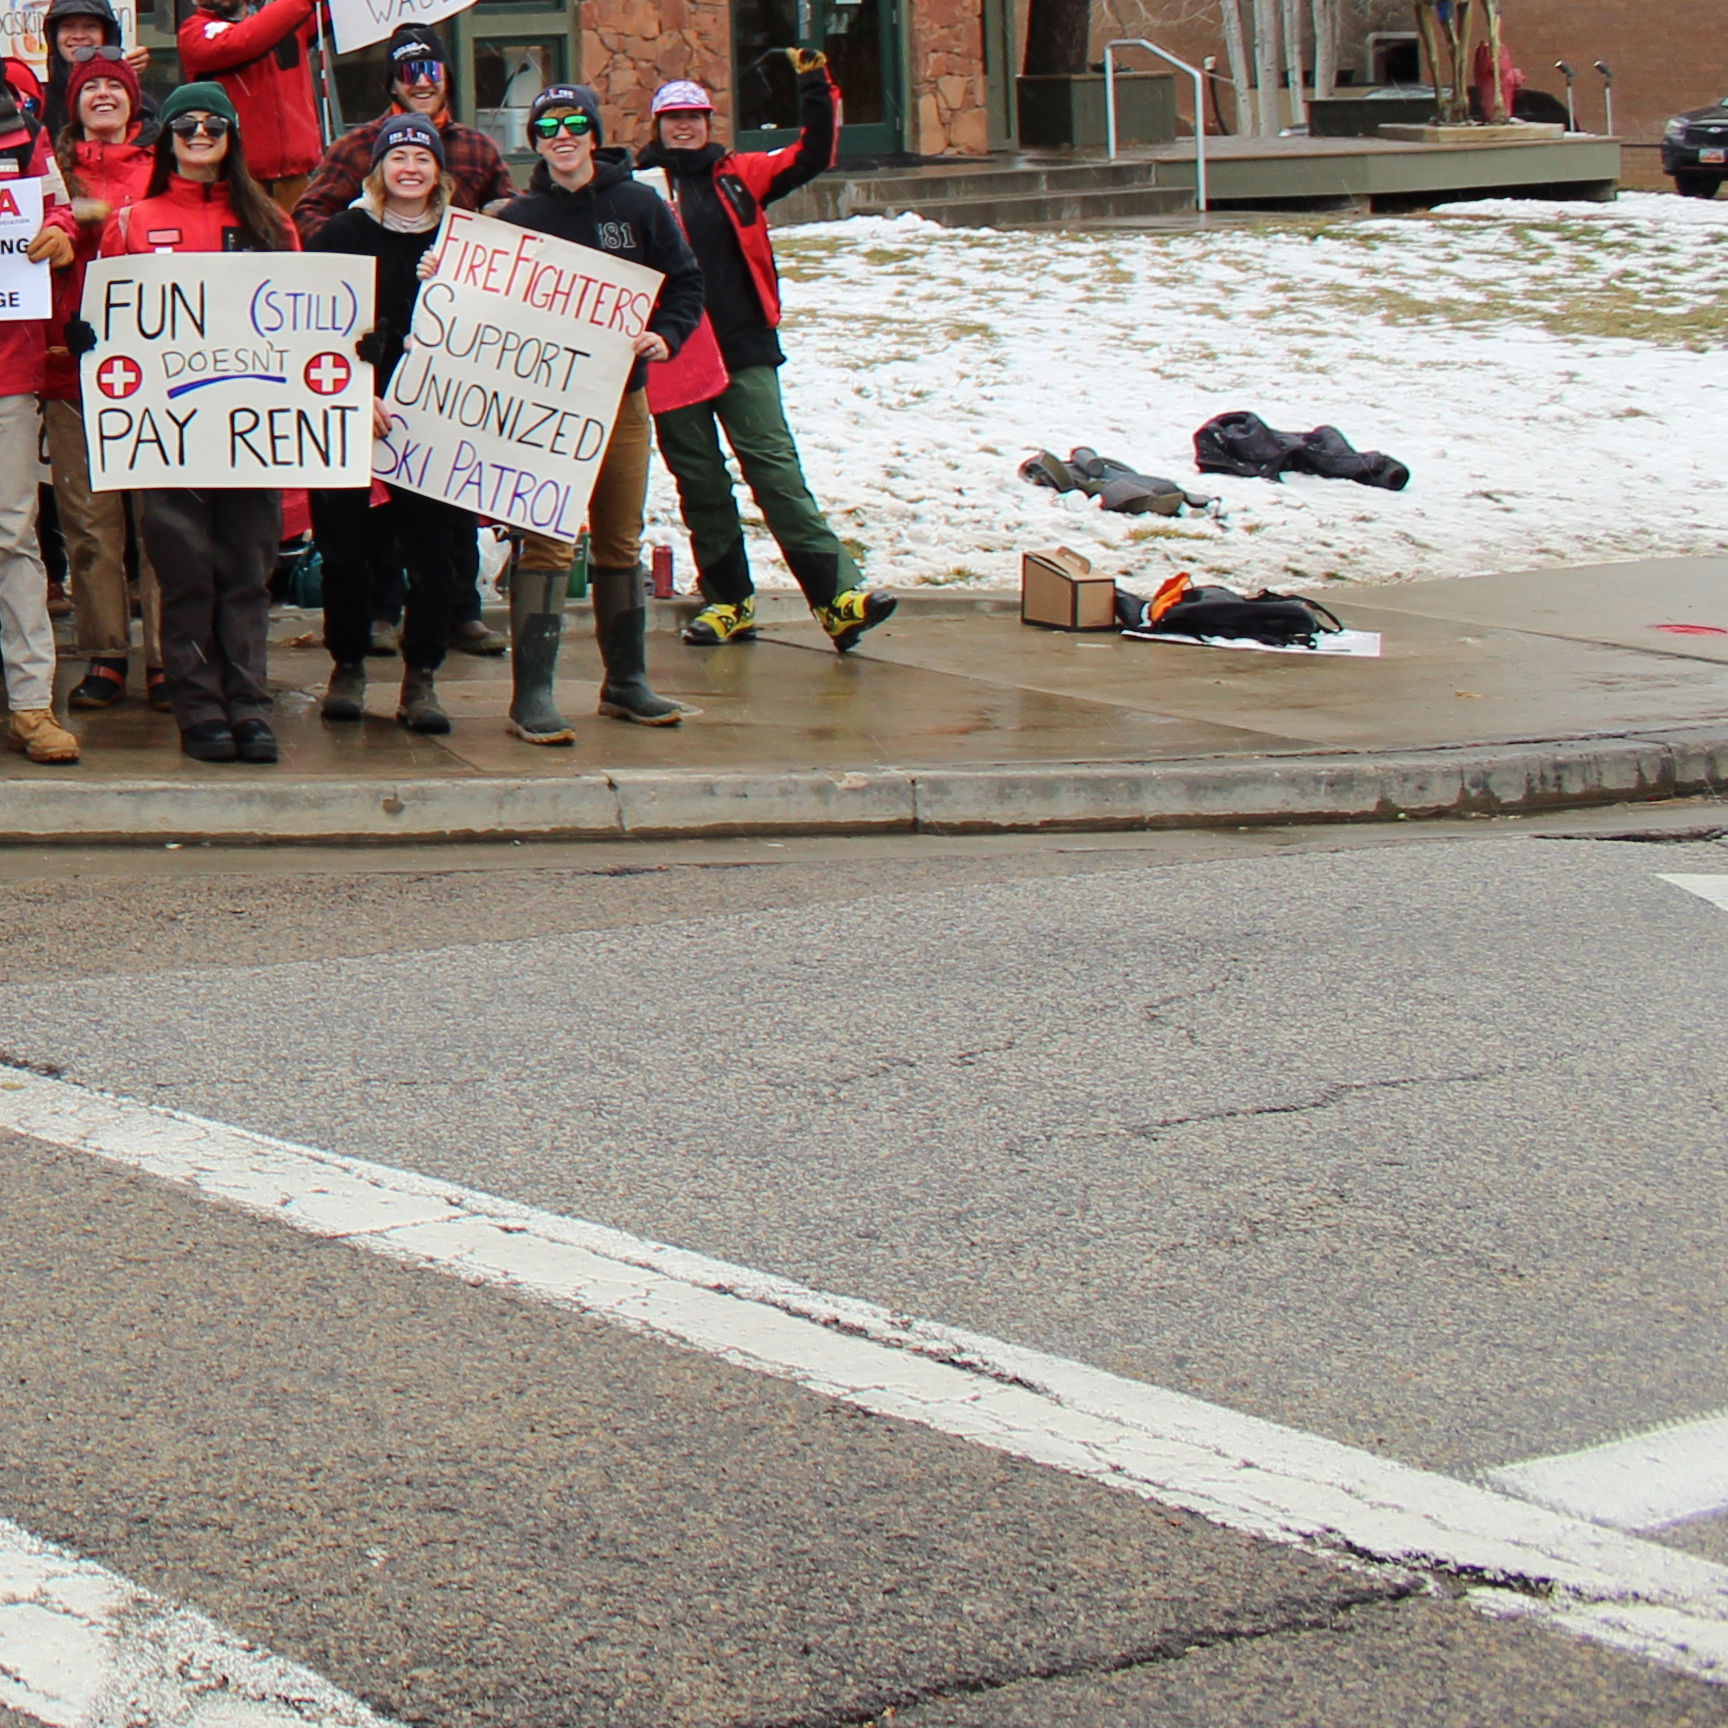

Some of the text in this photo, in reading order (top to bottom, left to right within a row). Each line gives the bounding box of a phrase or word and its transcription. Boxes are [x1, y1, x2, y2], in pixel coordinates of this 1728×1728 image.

[105, 279, 357, 341] FUN (STILL)
[437, 214, 651, 338] FIREFIGHTERS
[162, 340, 290, 379] DOESN'T
[413, 283, 591, 392] SUPPORT
[98, 406, 359, 472] PAY RENT
[395, 355, 605, 461] UNIONIZED
[373, 413, 575, 538] SKI PATROL
